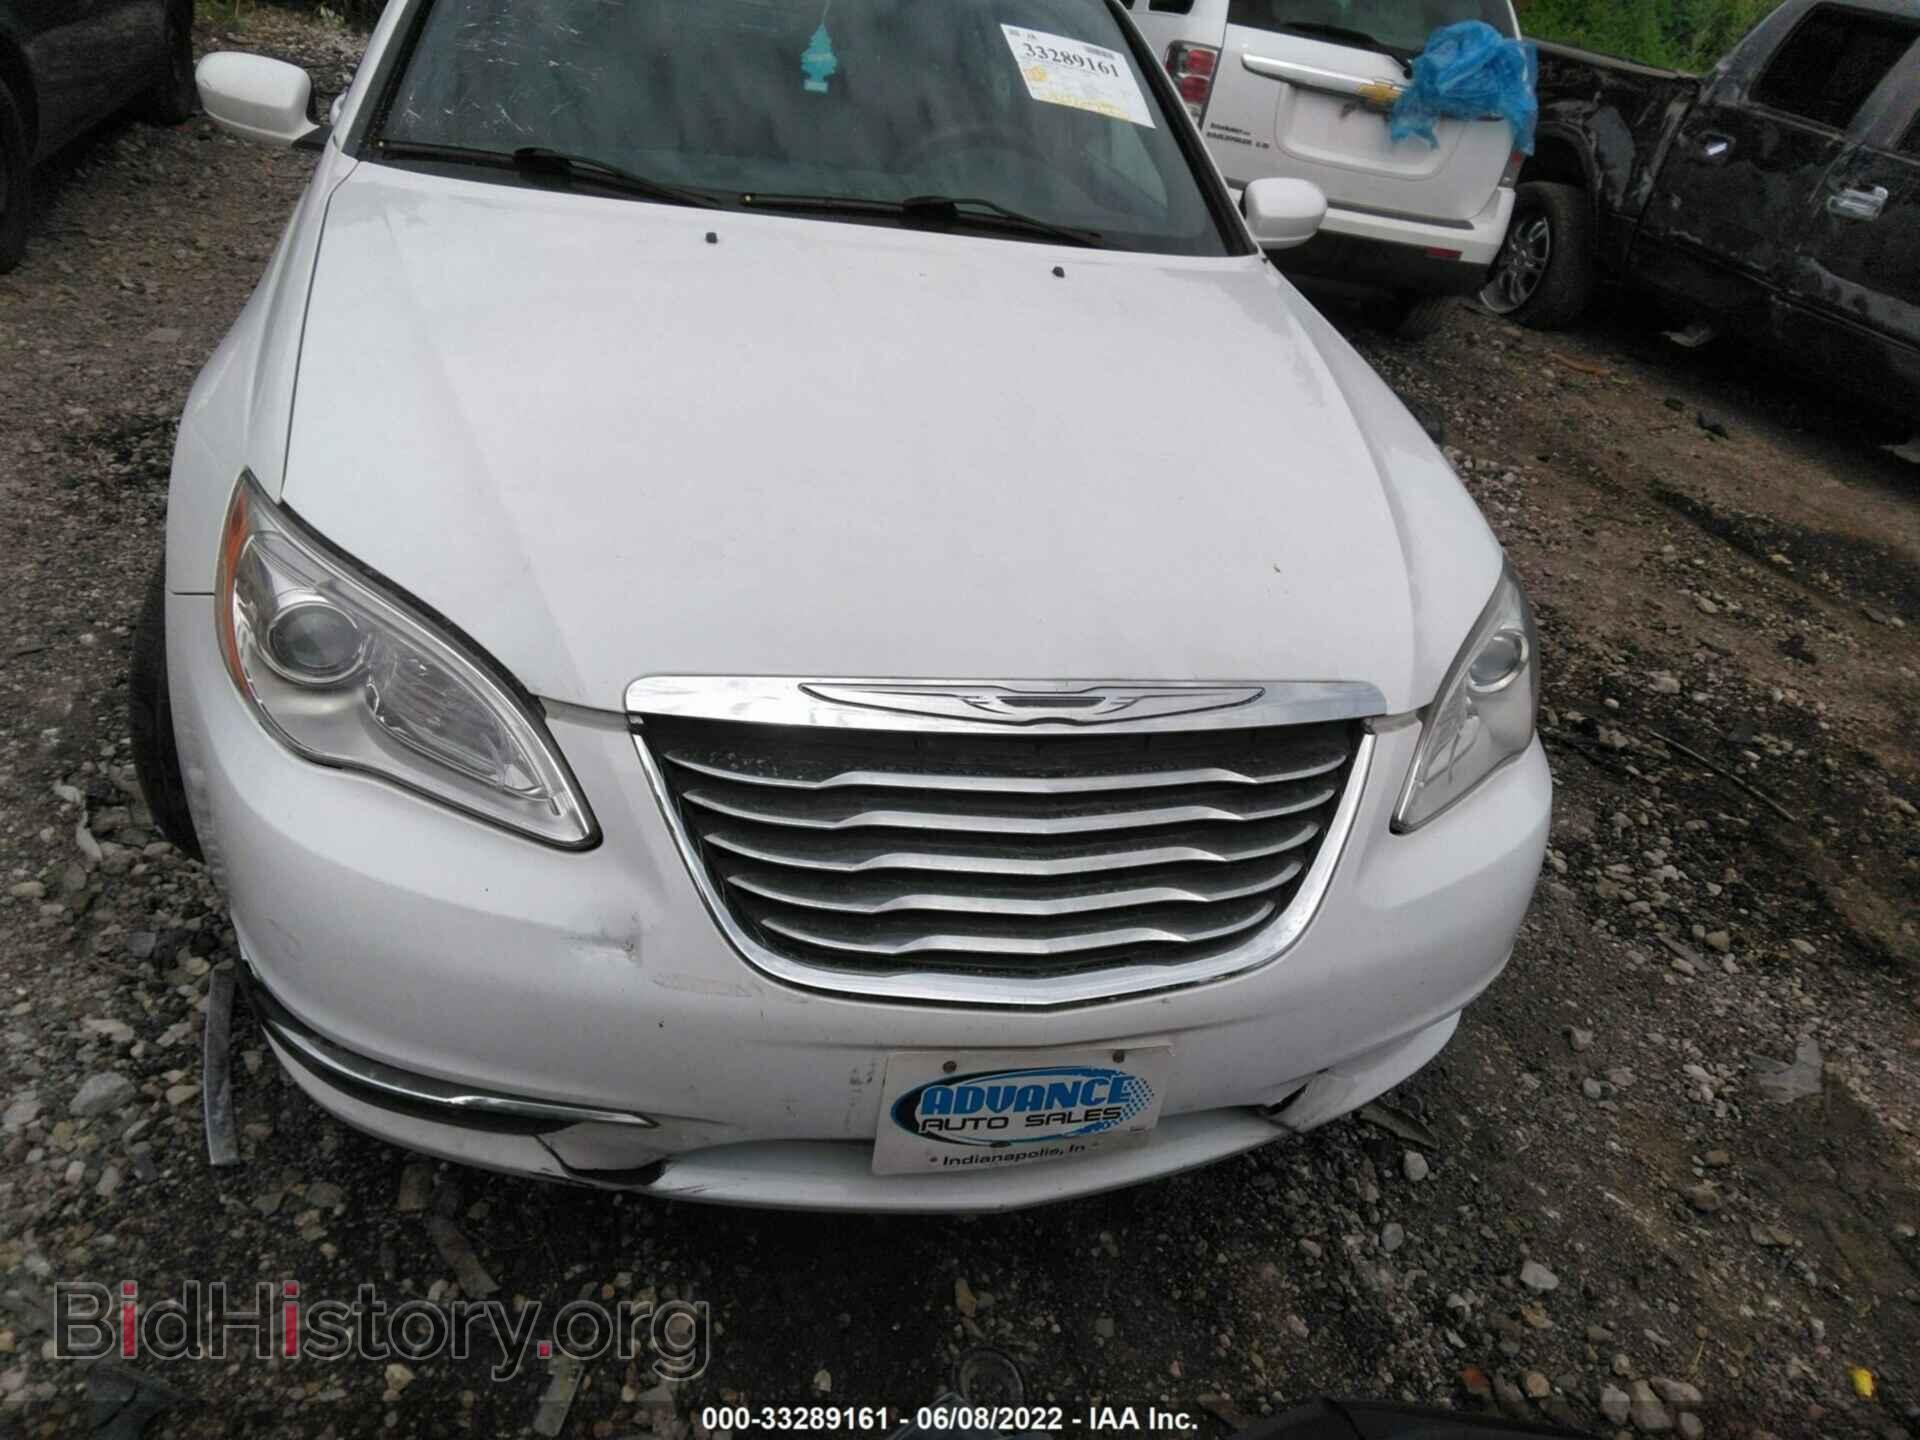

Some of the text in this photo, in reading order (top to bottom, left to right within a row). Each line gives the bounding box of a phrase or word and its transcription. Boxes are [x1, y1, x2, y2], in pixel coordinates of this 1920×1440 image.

[1022, 42, 1119, 78] 33289161
[919, 1076, 1134, 1115] ADVANCE
[918, 1106, 1122, 1133] AUTO SALES
[943, 1147, 1064, 1166] Indianapolis,
